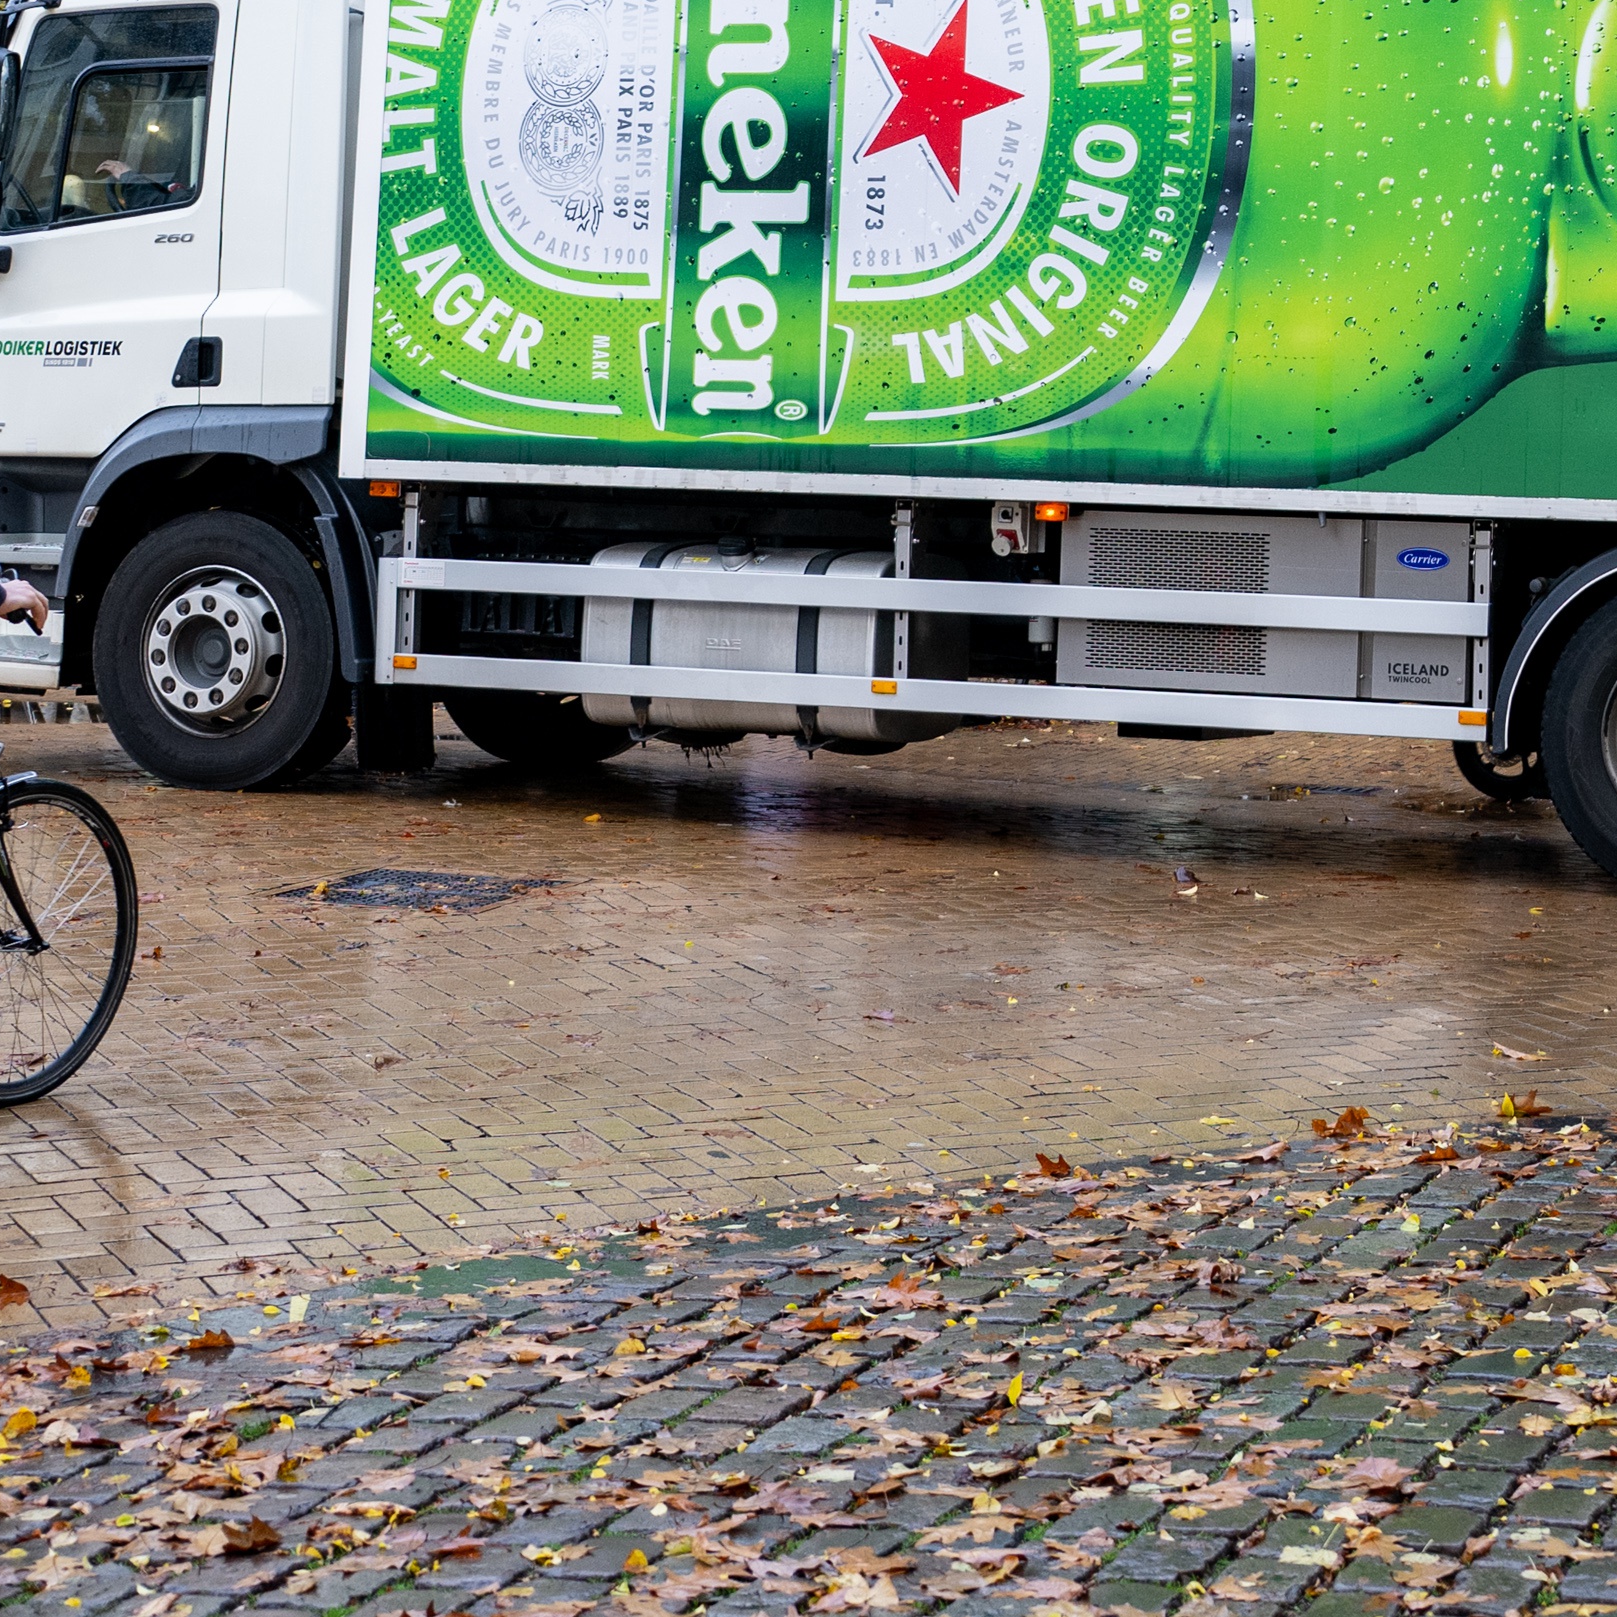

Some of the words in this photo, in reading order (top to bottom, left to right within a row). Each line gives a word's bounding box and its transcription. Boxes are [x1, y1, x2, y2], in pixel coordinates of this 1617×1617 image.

[483, 22, 512, 123] MEMBRE
[618, 46, 636, 97] PRIX
[1169, 2, 1194, 146] QUALITY
[484, 137, 504, 169] DU
[615, 107, 633, 163] PARIS
[636, 122, 655, 178] PARIS
[494, 182, 531, 232] JURY
[612, 177, 630, 220] 1889
[865, 174, 886, 231] 1873
[947, 119, 1022, 250] AMSTERDAM
[633, 189, 651, 232] 1875
[1140, 166, 1185, 263] LAGER
[154, 233, 194, 244] 260
[533, 231, 590, 264] PARIS
[604, 248, 649, 266] 1900
[852, 247, 902, 268] 1883
[892, 124, 1138, 383] ORIGINAL
[914, 241, 939, 265] EN
[390, 206, 544, 370] LAGER
[1097, 275, 1148, 339] BEER
[591, 335, 610, 380] MARK
[1404, 553, 1443, 565] Carrier
[1387, 663, 1449, 677] ICELAND
[1388, 676, 1431, 684] TWINCOOL
